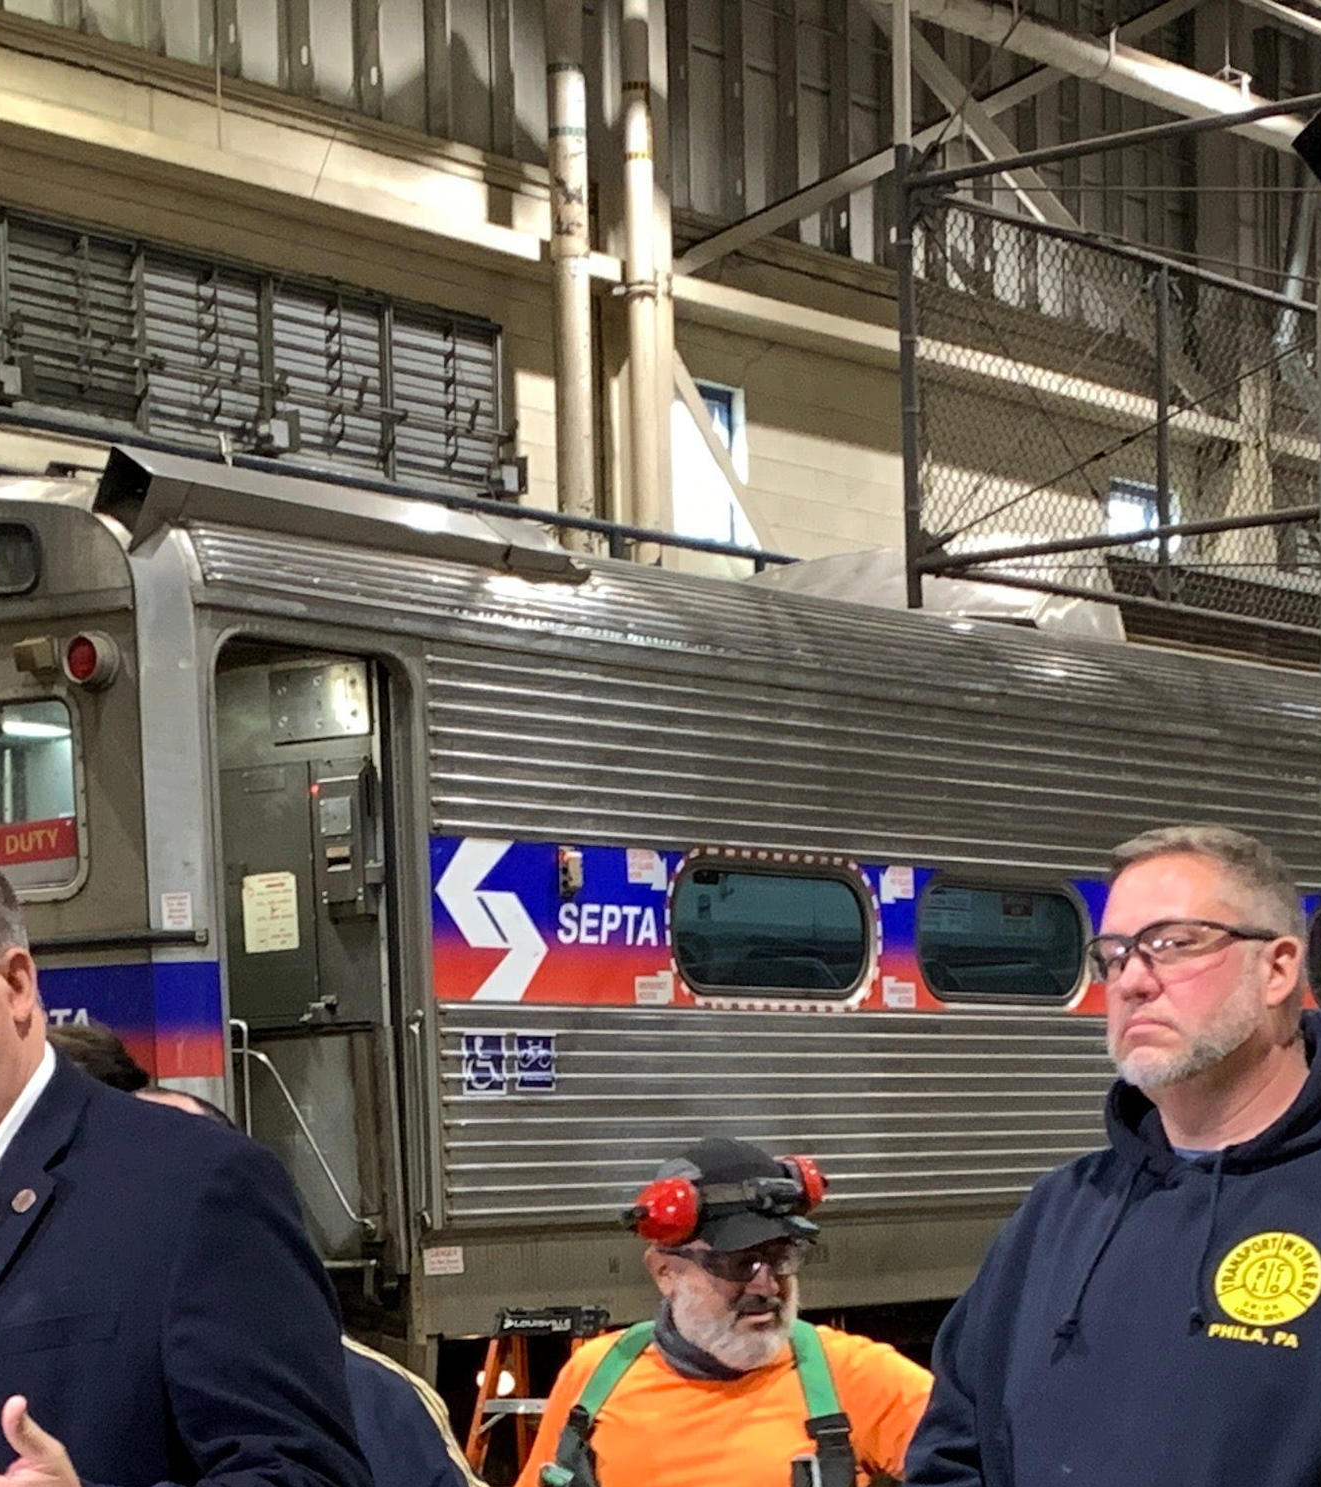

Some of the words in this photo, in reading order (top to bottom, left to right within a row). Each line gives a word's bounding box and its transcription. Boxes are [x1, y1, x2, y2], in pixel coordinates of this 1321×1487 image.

[5, 828, 59, 855] DUTY
[557, 902, 658, 947] SEPTA
[1221, 1237, 1279, 1291] TRANSPORT
[1283, 1240, 1319, 1300] WORKERS
[1208, 1323, 1269, 1346] PHILA,
[1273, 1331, 1299, 1349] PA
